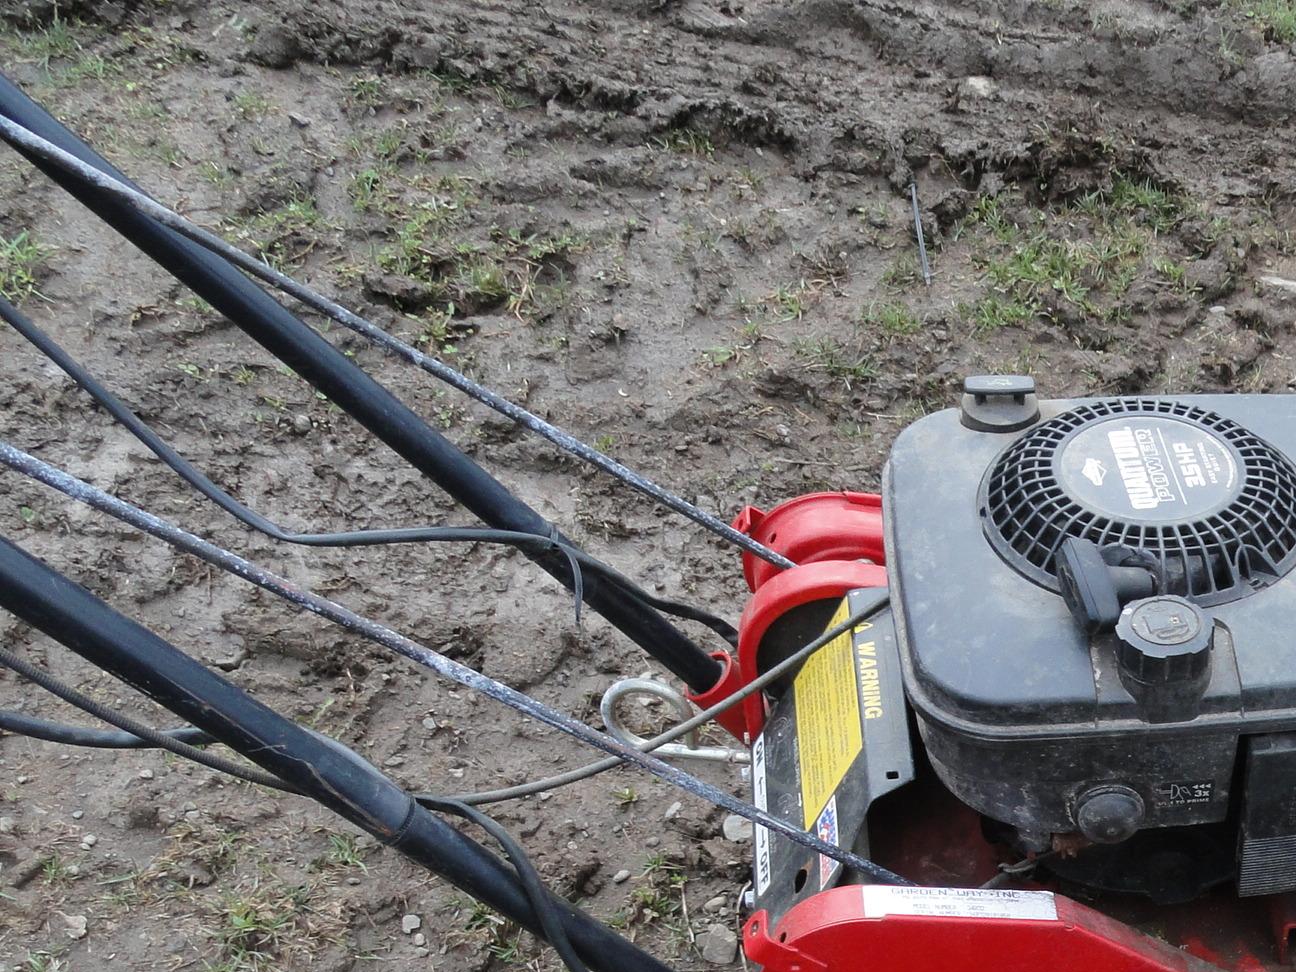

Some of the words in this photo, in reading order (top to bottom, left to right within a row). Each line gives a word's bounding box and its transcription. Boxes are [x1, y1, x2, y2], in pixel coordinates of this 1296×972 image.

[1108, 431, 1158, 509] QUANTUM
[1135, 429, 1175, 501] POWER
[858, 641, 883, 719] WARNING
[756, 741, 763, 767] ON
[760, 852, 768, 885] OFF
[891, 888, 948, 896] GARDEN
